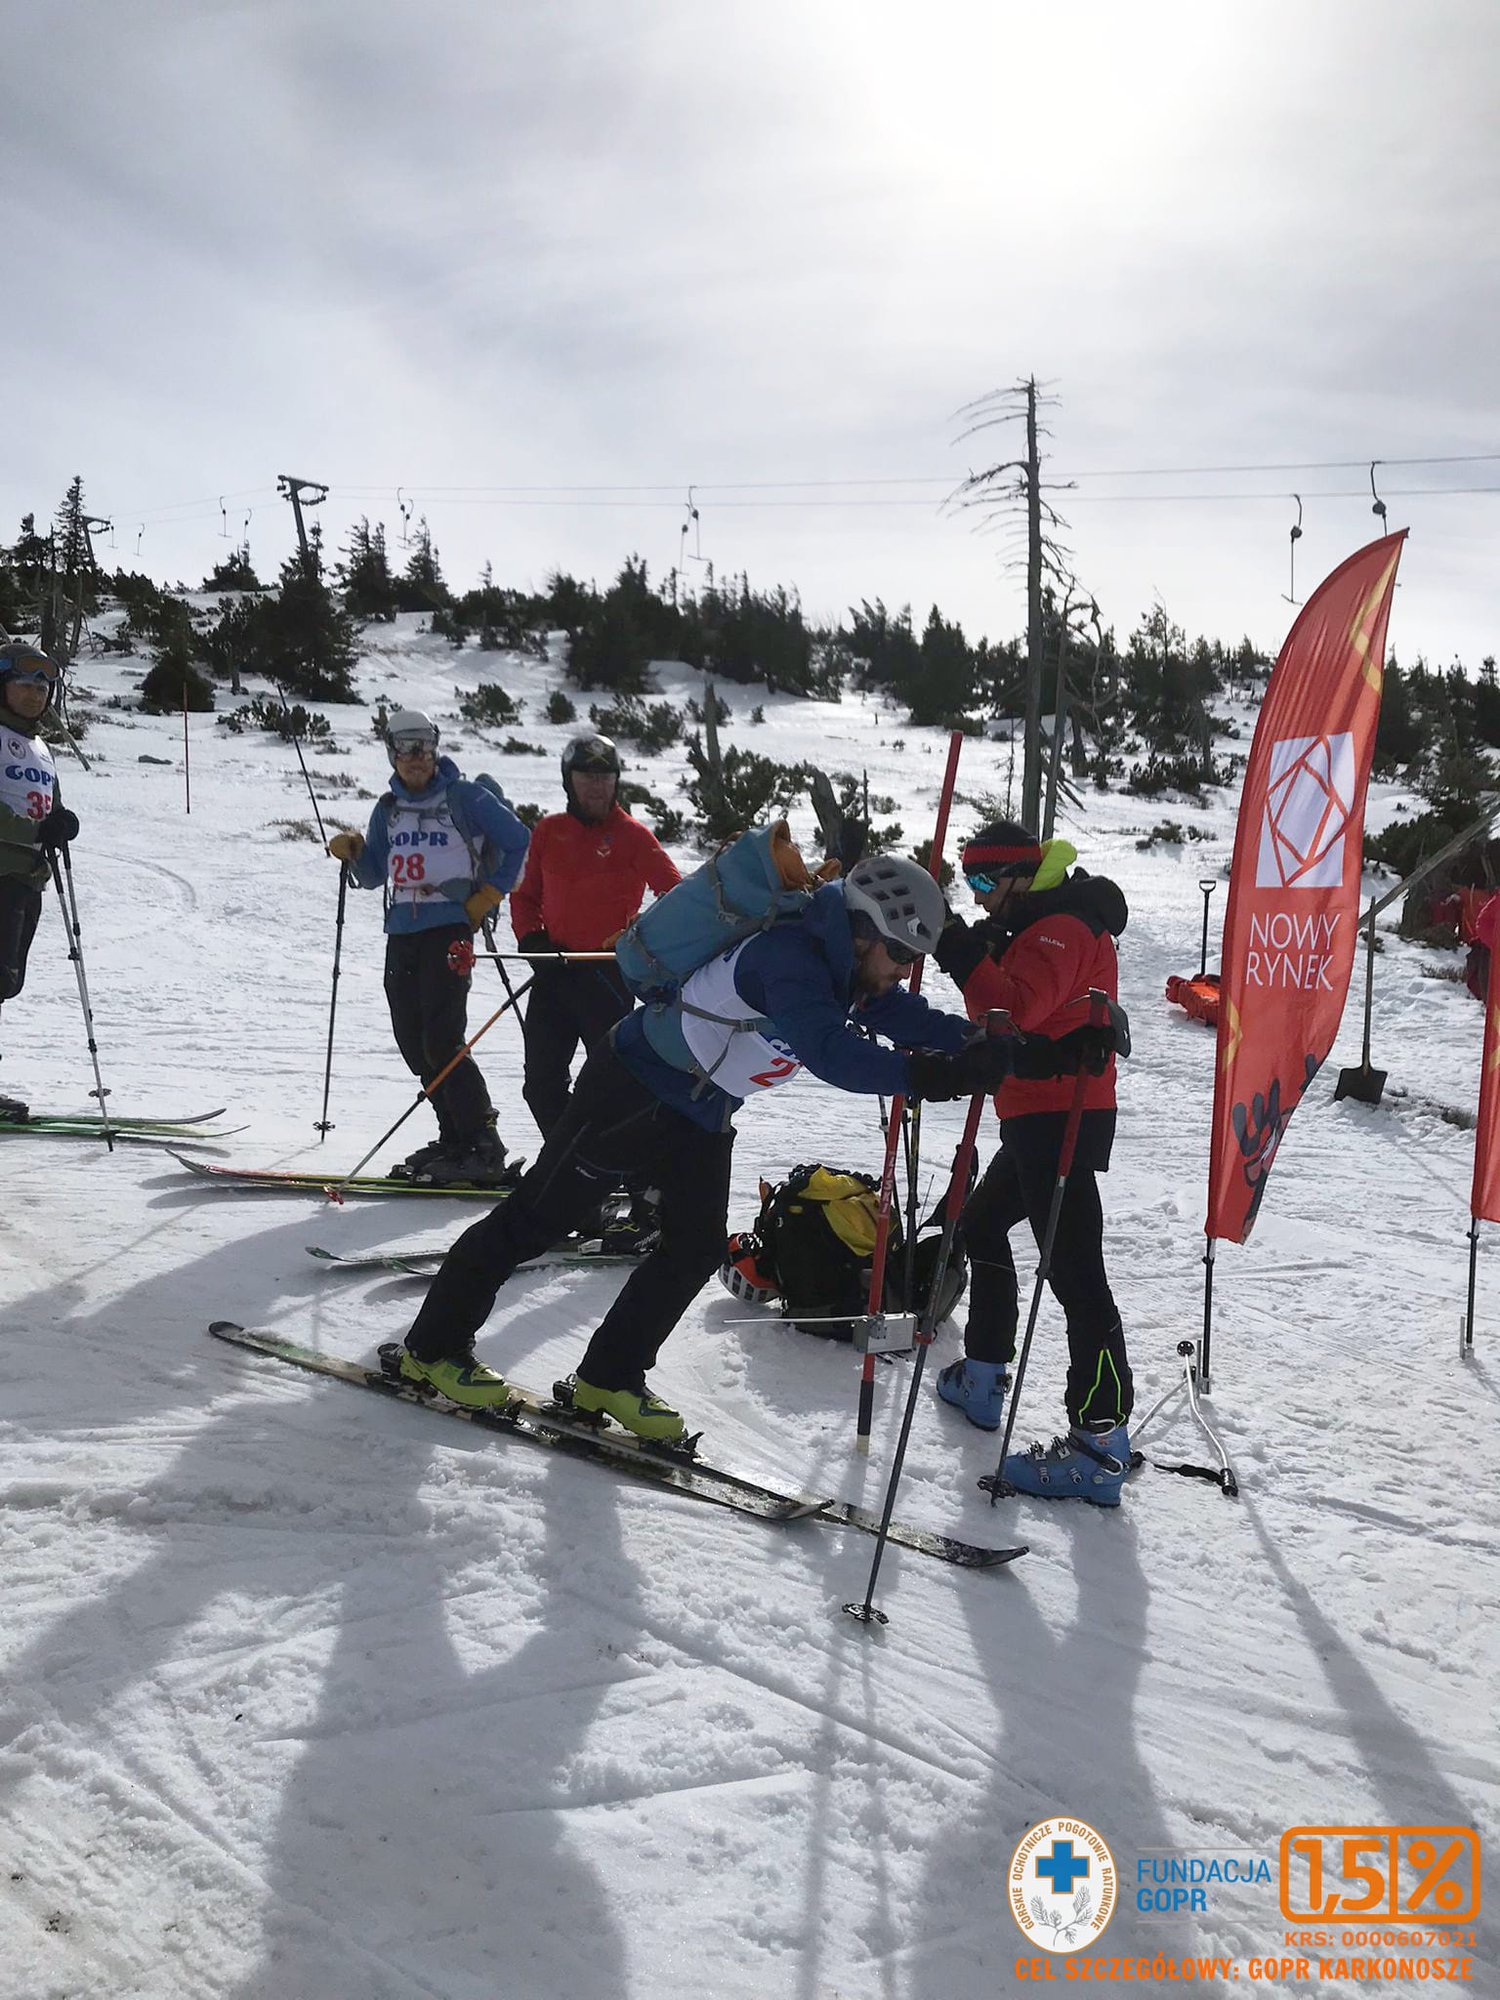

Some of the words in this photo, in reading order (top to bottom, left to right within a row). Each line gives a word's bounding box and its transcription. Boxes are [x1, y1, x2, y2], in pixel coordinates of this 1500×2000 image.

[5, 765, 55, 785] GOP
[391, 853, 425, 884] 28
[1249, 912, 1341, 950] NOWY
[1246, 951, 1334, 991] RYNEK
[749, 1057, 802, 1087] 2
